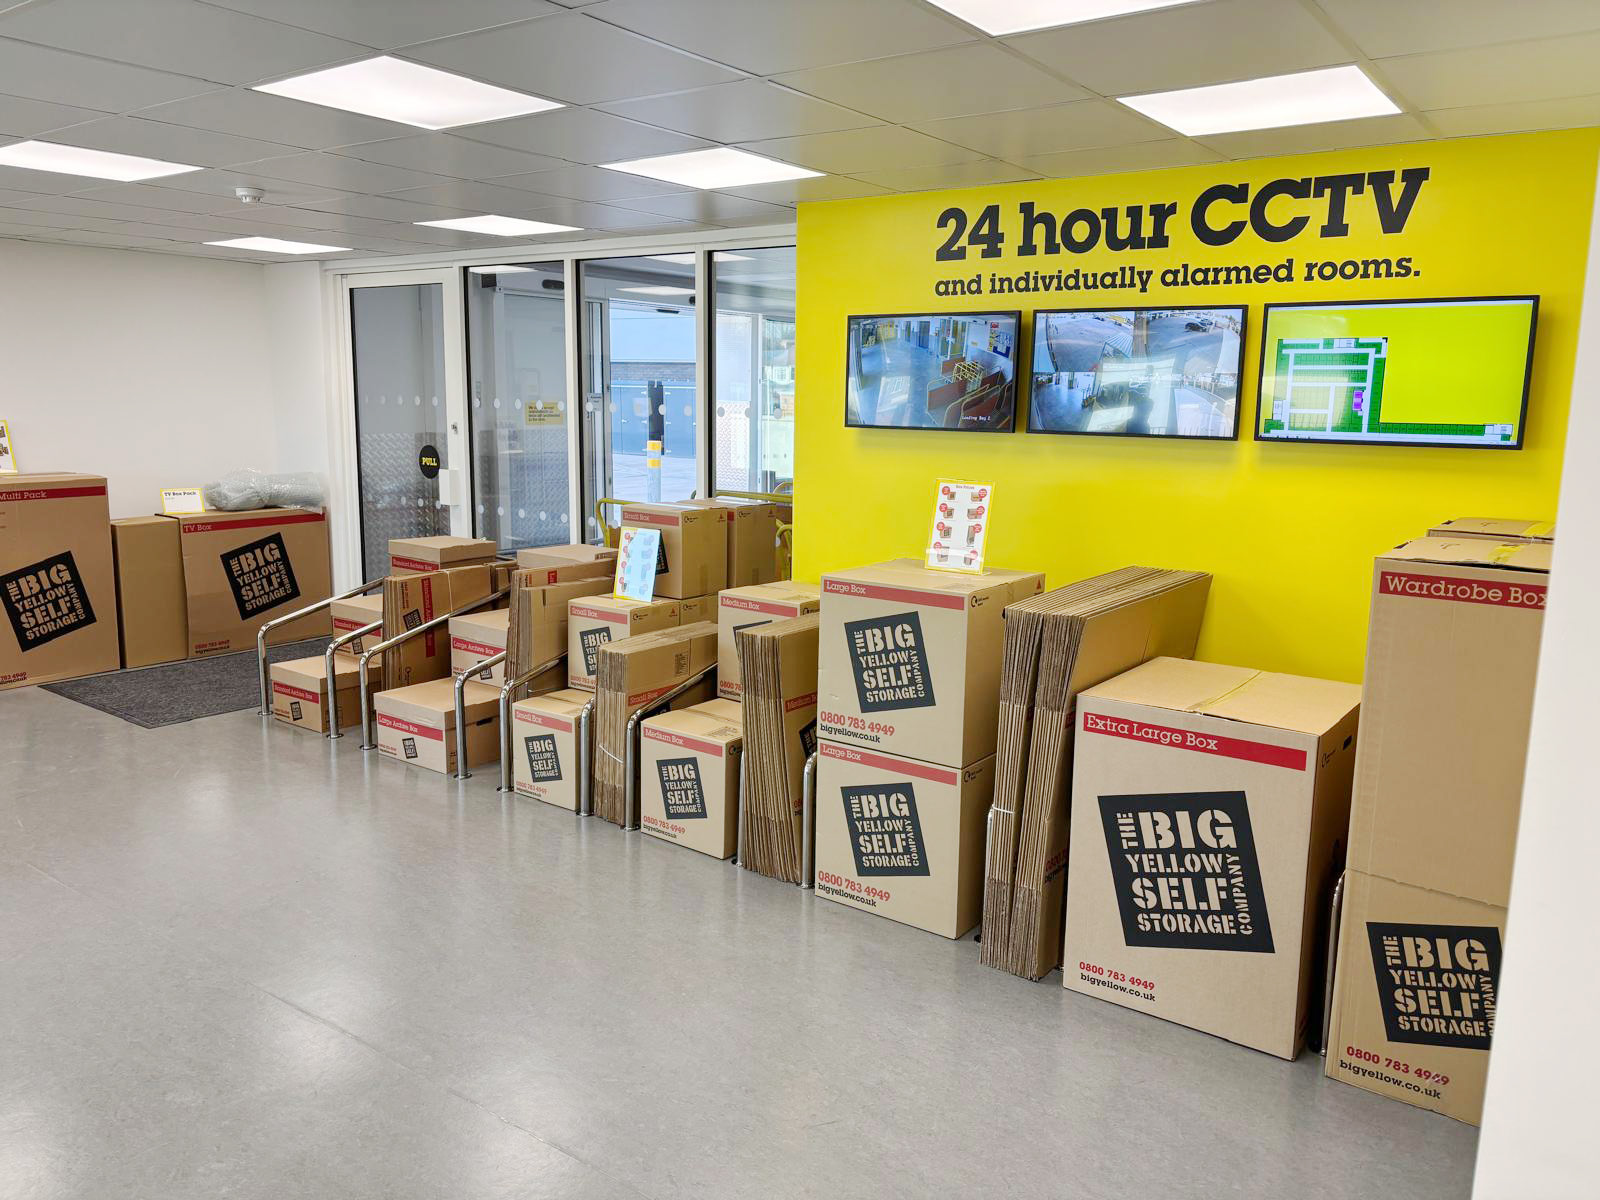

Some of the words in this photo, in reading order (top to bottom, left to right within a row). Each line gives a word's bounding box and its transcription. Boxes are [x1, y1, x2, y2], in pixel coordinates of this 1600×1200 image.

[935, 204, 1004, 261] 24
[1017, 201, 1178, 257] hour
[1191, 167, 1430, 246] CCTV
[935, 274, 982, 297] and
[989, 265, 1153, 294] individually
[1160, 258, 1294, 287] alarmed
[1303, 257, 1421, 282] rooms.
[421, 456, 437, 466] PULL
[24, 490, 48, 499] Pack
[230, 557, 243, 577] THE
[240, 543, 281, 574] BIG
[18, 563, 72, 598] BIG
[236, 562, 280, 586] YELLOW
[278, 560, 292, 594] COMPANY
[6, 581, 18, 602] THE
[14, 584, 68, 613] YELLOW
[240, 574, 281, 600] SELF
[245, 587, 286, 611] STORAGE
[826, 581, 850, 595] Large
[851, 583, 866, 594] Box
[1385, 575, 1503, 602] Wardrobe
[20, 598, 72, 629] SELF
[67, 583, 85, 620] COMPANY
[722, 598, 748, 608] Medium
[748, 602, 760, 610] Box
[587, 610, 598, 618] Box
[25, 612, 78, 642] STORAGE
[865, 623, 916, 653] BIG
[588, 632, 609, 647] BIG
[854, 630, 867, 654] THE
[859, 650, 909, 668] YELLOW
[720, 680, 734, 690] 0800
[863, 665, 912, 689] SELF
[909, 650, 925, 698] COMPANY
[866, 685, 917, 703] STORAGE
[532, 714, 542, 723] Box
[820, 711, 846, 727] 0800
[847, 715, 866, 731] 783
[867, 720, 895, 737] 4949
[645, 728, 671, 742] Medium
[671, 735, 684, 745] Box
[820, 723, 881, 743] bigyellow.co.uk
[1086, 715, 1129, 735] Extra
[1132, 723, 1183, 745] Large
[1186, 733, 1218, 750] Box
[530, 752, 553, 760] YELLOW
[532, 738, 554, 753] BIG
[823, 744, 845, 760] Large
[846, 748, 861, 761] Box
[532, 759, 553, 771] SELF
[667, 764, 696, 780] BIG
[665, 780, 693, 790] YELLOW
[667, 789, 695, 805] SELF
[670, 804, 698, 813] STORAGE
[850, 794, 862, 818] THE
[861, 792, 909, 818] BIG
[643, 816, 658, 826] 0800
[658, 820, 669, 829] 783
[670, 823, 685, 834] 4949
[855, 818, 905, 833] YELLOW
[1116, 811, 1139, 849] THE
[1138, 809, 1238, 849] BIG
[859, 833, 908, 854] SELF
[903, 818, 920, 867] COMPANY
[862, 853, 912, 868] STORAGE
[1125, 853, 1223, 874] YELLOW
[818, 870, 843, 887] 0800
[844, 877, 862, 894] 783
[864, 882, 891, 901] 4949
[818, 882, 876, 907] bigyellow.co.uk
[1132, 877, 1228, 911] SELF
[1226, 853, 1253, 935] COMPANY
[1137, 913, 1237, 935] STORAGE
[1383, 936, 1402, 966] THE
[1402, 936, 1490, 972] BIG
[1079, 960, 1104, 977] 0800
[1107, 967, 1126, 982] 783
[1129, 973, 1155, 991] 4949
[1080, 972, 1156, 1002] bigyellow.co.uk
[1389, 969, 1477, 990] YELLOW
[1394, 988, 1480, 1018] SELF
[1398, 1016, 1486, 1037] STORAGE
[1346, 1046, 1380, 1064] 0800
[1385, 1057, 1409, 1074] 783
[1339, 1059, 1441, 1099] bigyellow.co.uk
